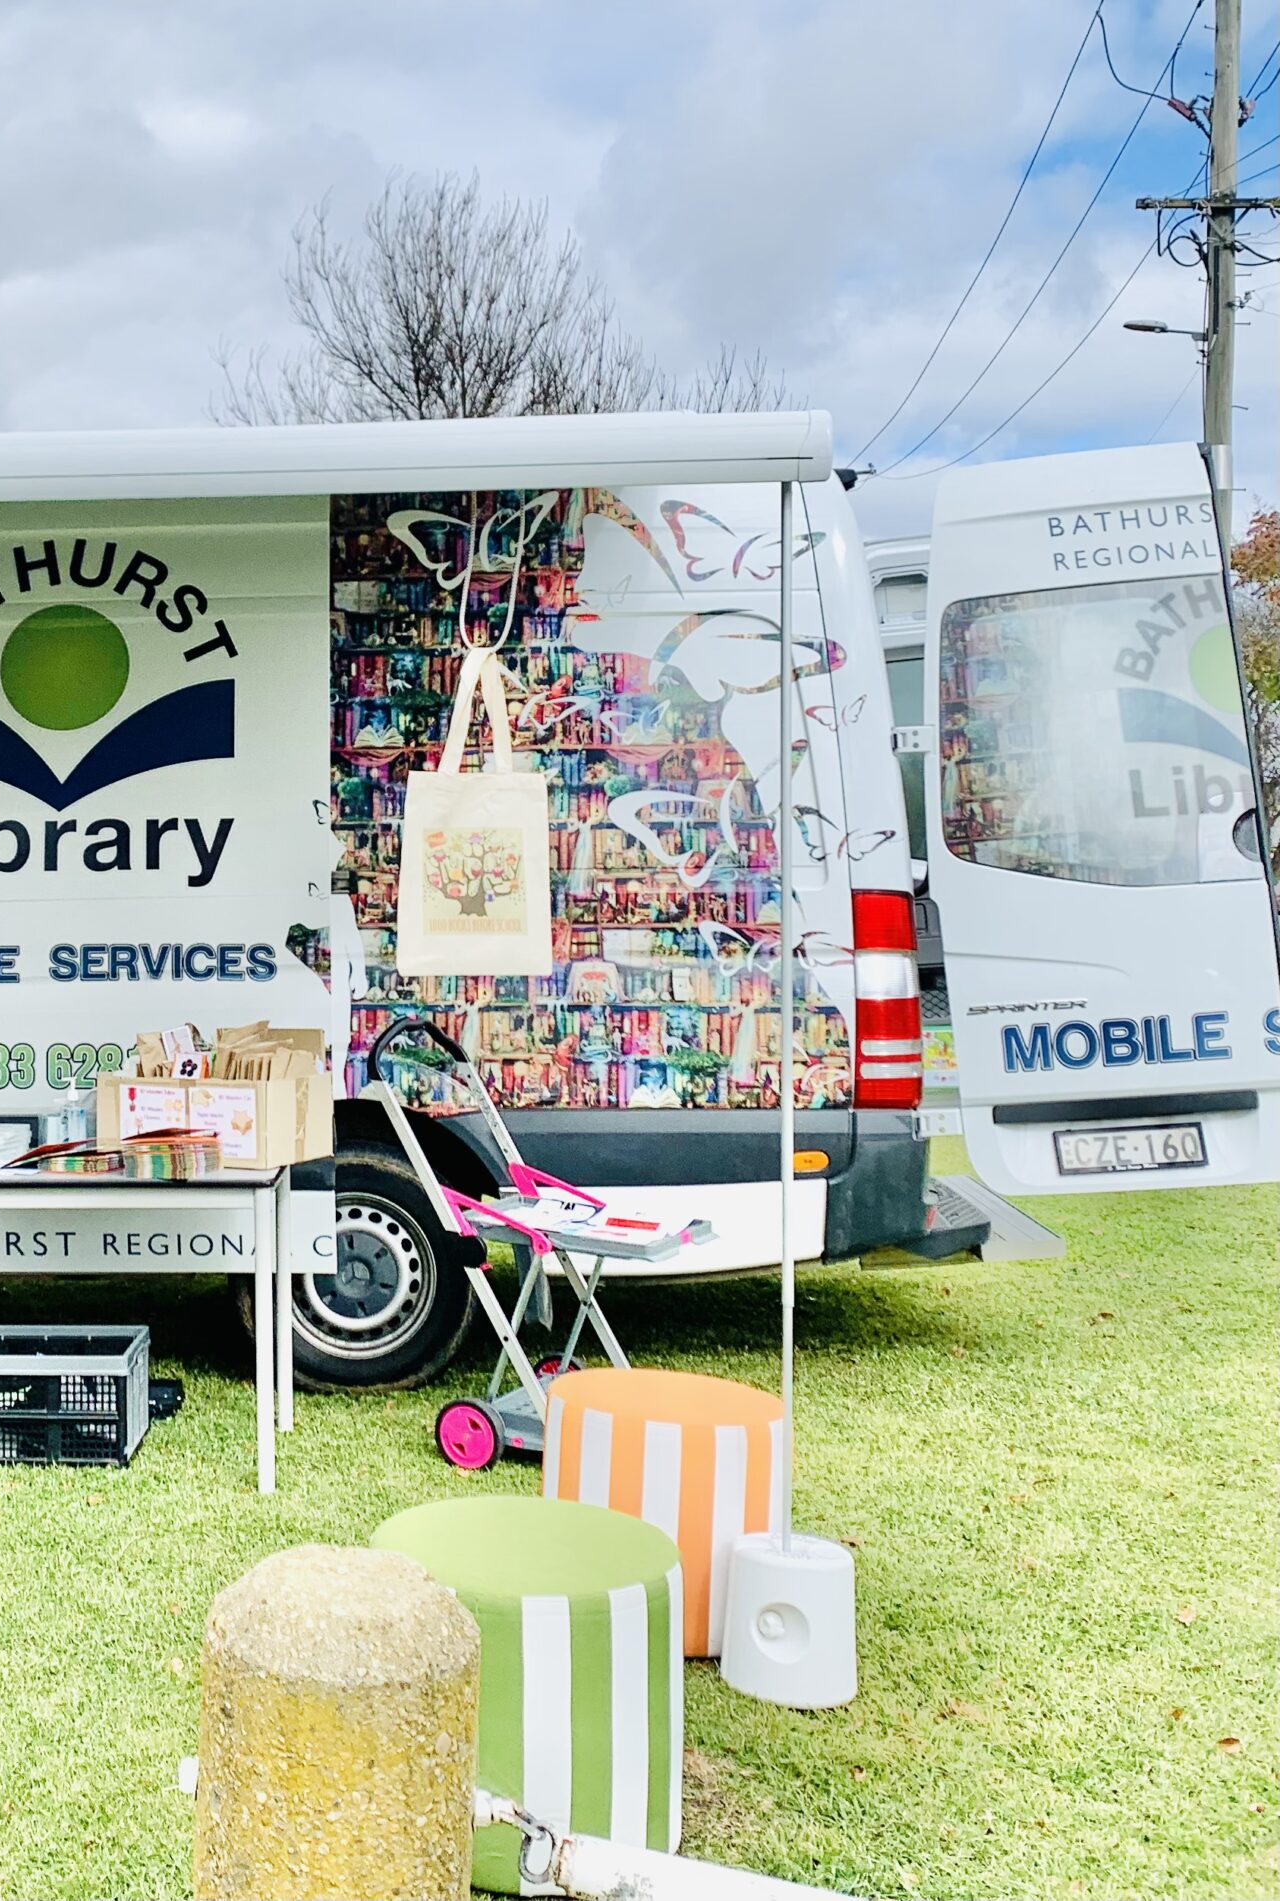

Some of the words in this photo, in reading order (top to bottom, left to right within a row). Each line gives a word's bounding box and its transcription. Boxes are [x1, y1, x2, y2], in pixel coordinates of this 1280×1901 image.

[1048, 502, 1213, 538] BATHURS
[1053, 538, 1218, 571] REGIONAL
[1114, 578, 1222, 682] BATH
[49, 943, 278, 982] SERVICES
[966, 999, 1087, 1016] SPRINTER
[1001, 1011, 1233, 1074] MOBILE
[46, 1042, 137, 1090] 628
[103, 1232, 293, 1257] REGION
